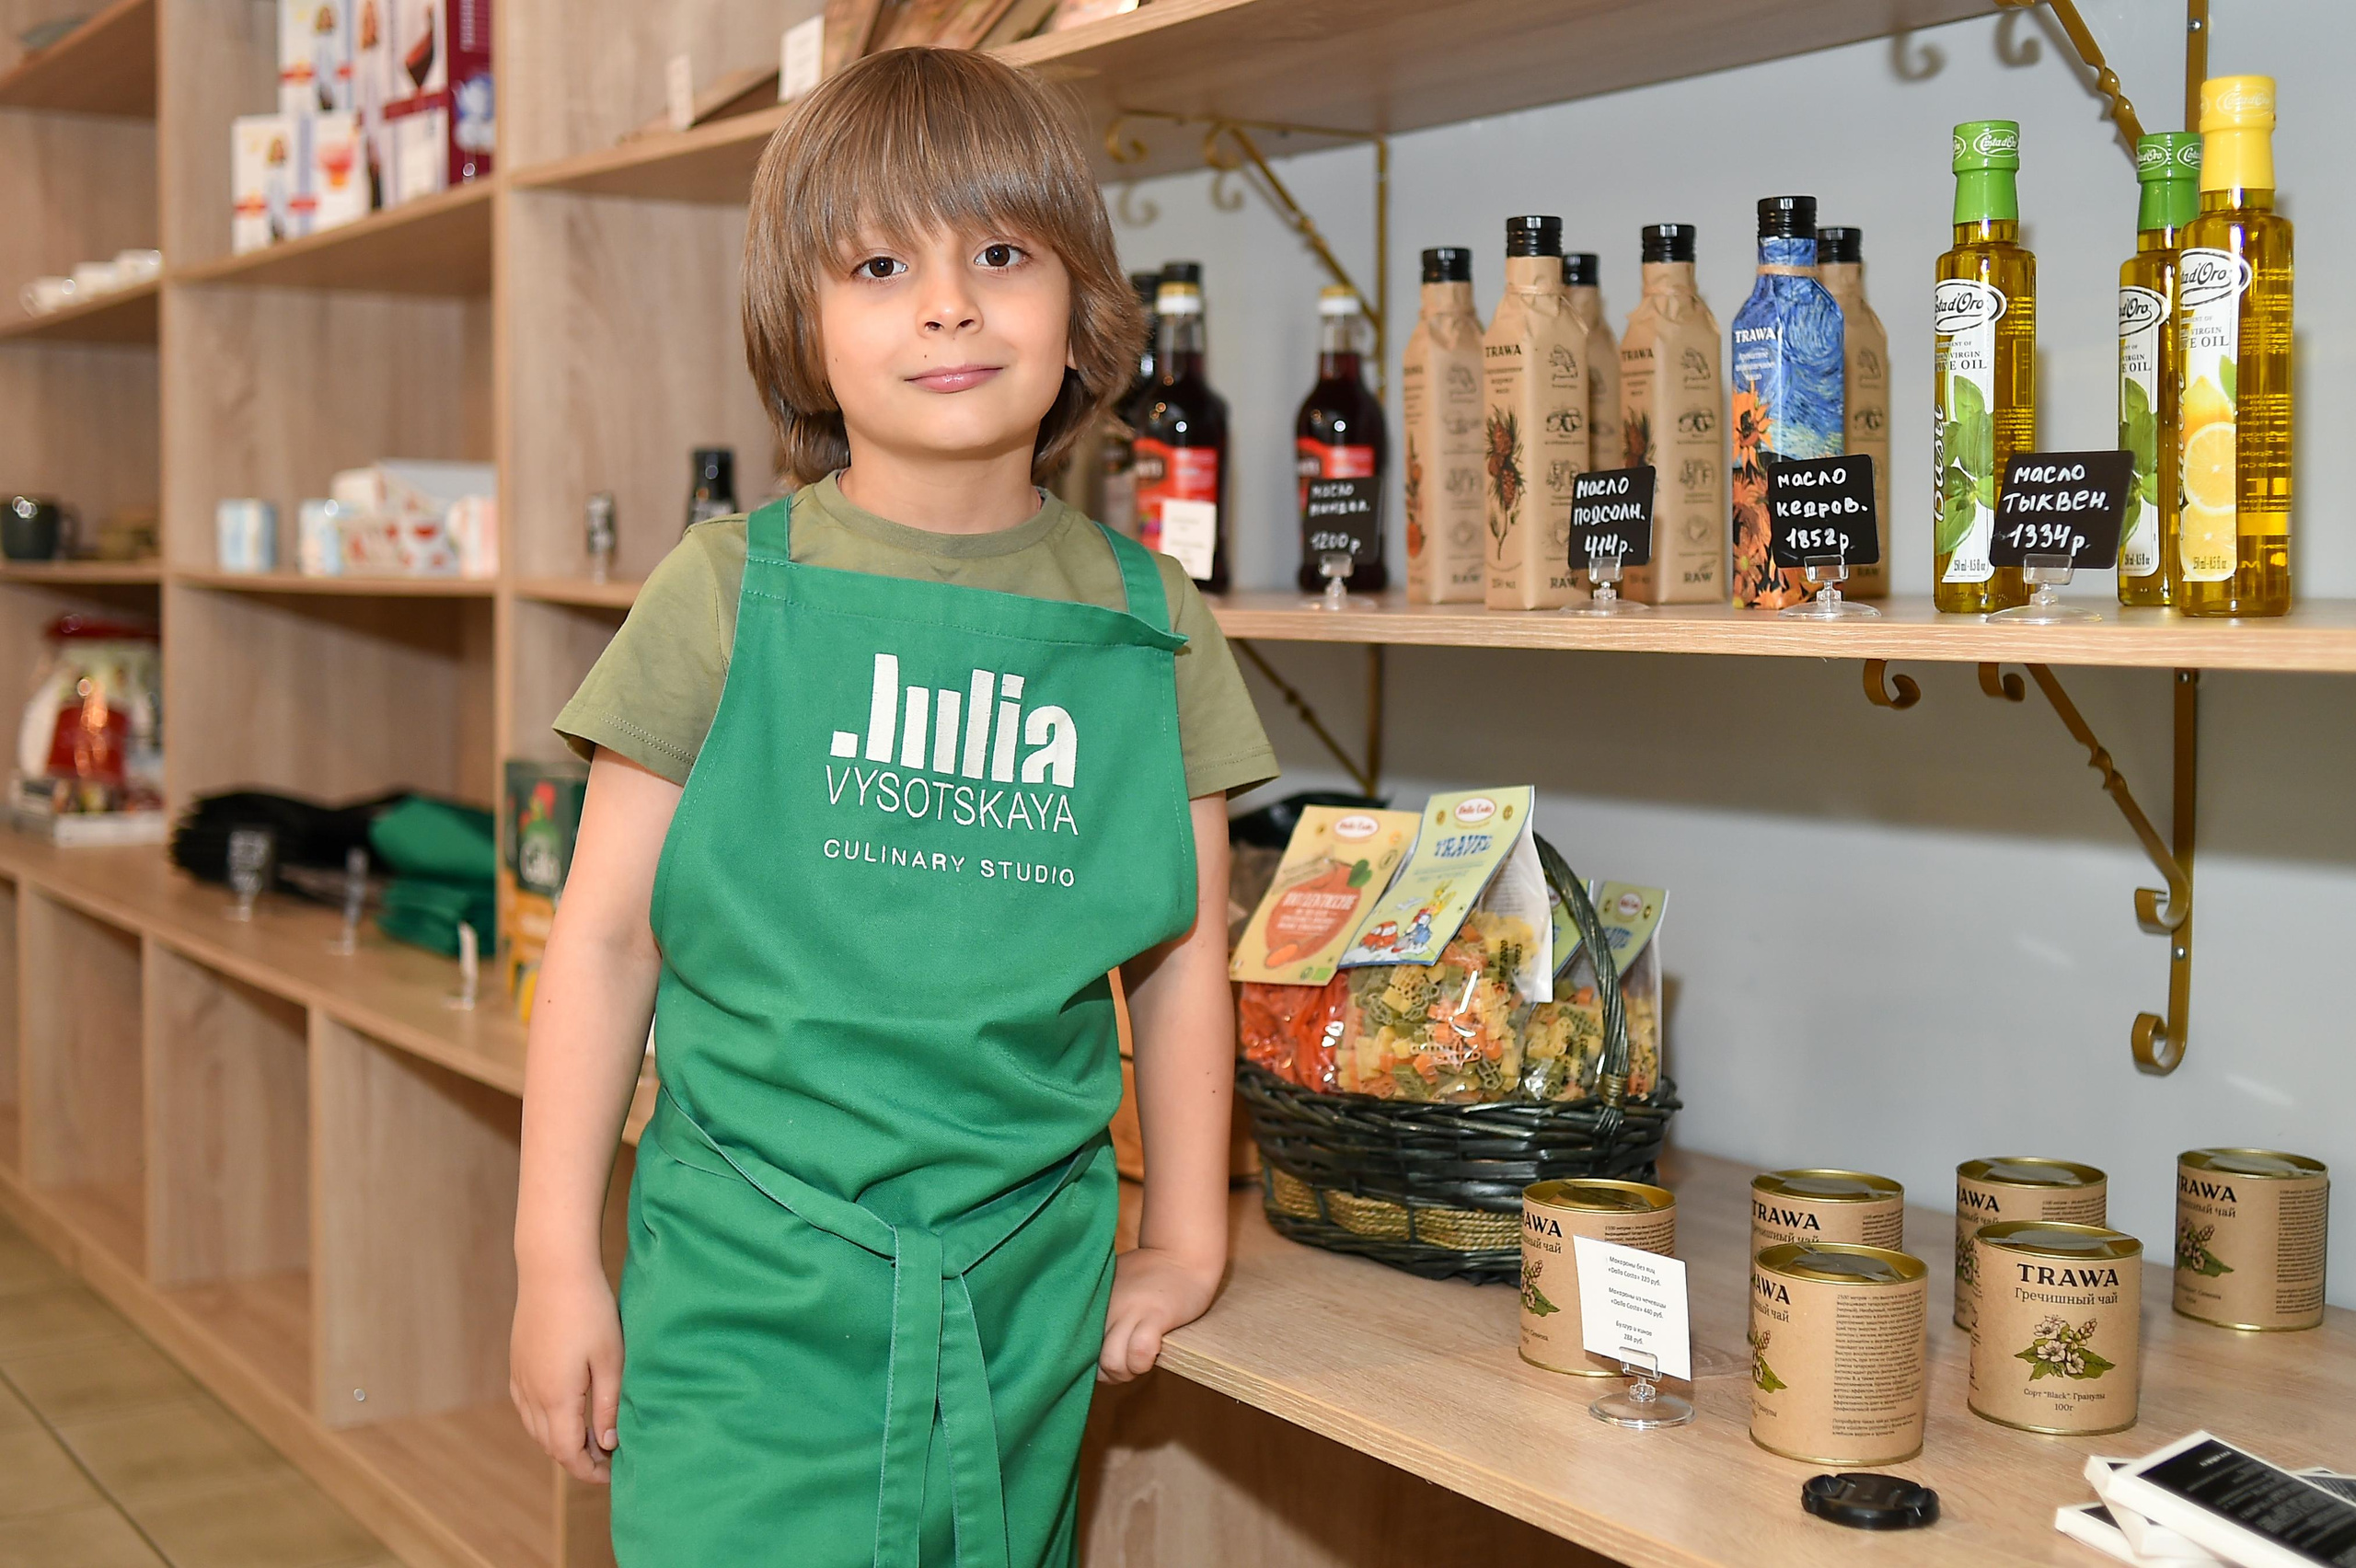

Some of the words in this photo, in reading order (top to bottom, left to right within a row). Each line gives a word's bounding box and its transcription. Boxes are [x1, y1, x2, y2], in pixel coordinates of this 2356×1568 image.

[1734, 326, 1777, 343] TRAWA
[2200, 335, 2229, 348] OIL
[1485, 344, 1521, 358] TRAWA
[1621, 348, 1654, 361] TRAWA
[1960, 359, 1988, 370] OIL
[2129, 362, 2151, 372] OIL
[1550, 576, 1579, 590] RAW
[830, 651, 1078, 789] Julia
[826, 765, 1080, 836] VYSOTSKAYA
[1434, 834, 1495, 859] TRAVEL
[823, 838, 965, 872] CULINARY
[980, 859, 1075, 887] STUDIO
[2179, 1175, 2237, 1203] RAWA
[1752, 1199, 1821, 1230] TRAWA
[1542, 1242, 1562, 1254] чай
[1610, 1256, 1635, 1269] Макароны
[1636, 1263, 1646, 1272] без
[1641, 1274, 1651, 1284] 220
[2016, 1262, 2119, 1288] TRAWA
[1609, 1287, 1635, 1300] Макароны
[2015, 1287, 2095, 1306] Гречишный
[2097, 1292, 2118, 1305] чай
[1644, 1308, 1653, 1316] 440
[1771, 1309, 1789, 1323] чай
[1615, 1320, 1633, 1332] Булгур
[1623, 1333, 1633, 1342] 288
[2024, 1388, 2042, 1398] Сорт
[2073, 1392, 2106, 1402] Гранулы
[2054, 1403, 2074, 1412] 100г
